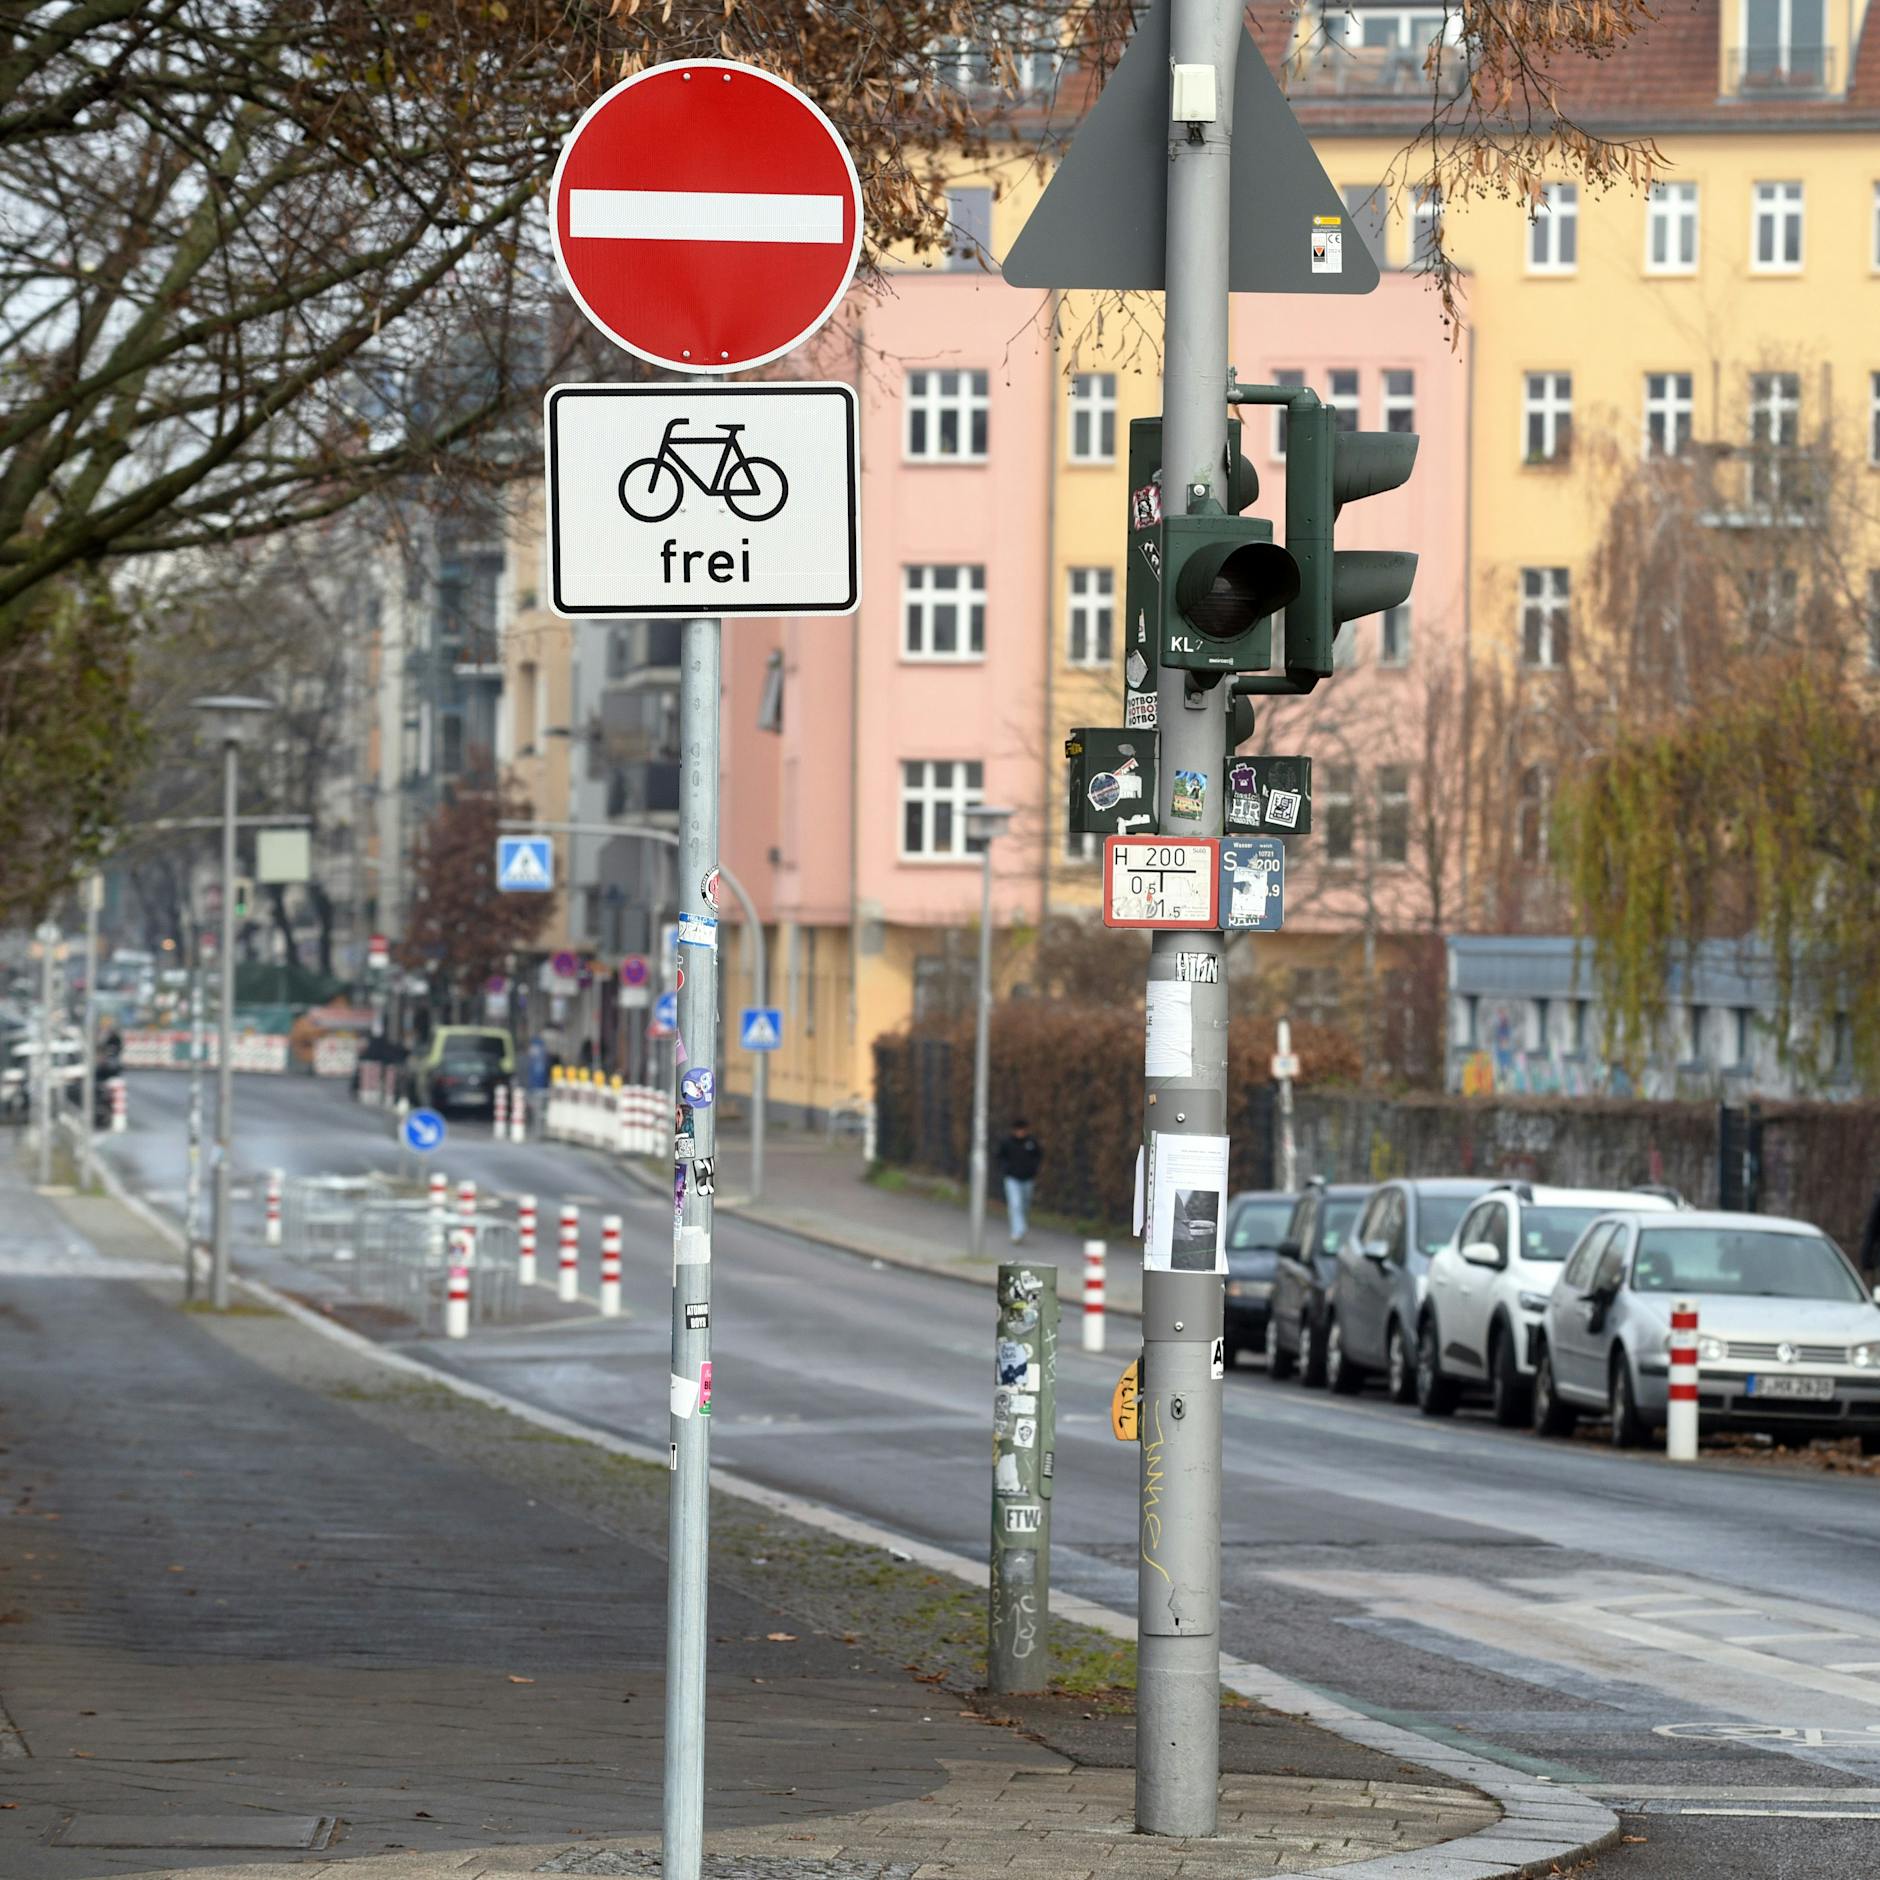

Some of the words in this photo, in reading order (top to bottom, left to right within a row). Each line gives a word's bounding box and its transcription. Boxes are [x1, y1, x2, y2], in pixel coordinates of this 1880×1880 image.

[660, 538, 750, 583] frei
[1115, 847, 1128, 865] H
[1146, 847, 1185, 867] 200
[1223, 851, 1238, 871] S
[1256, 859, 1280, 872] 200
